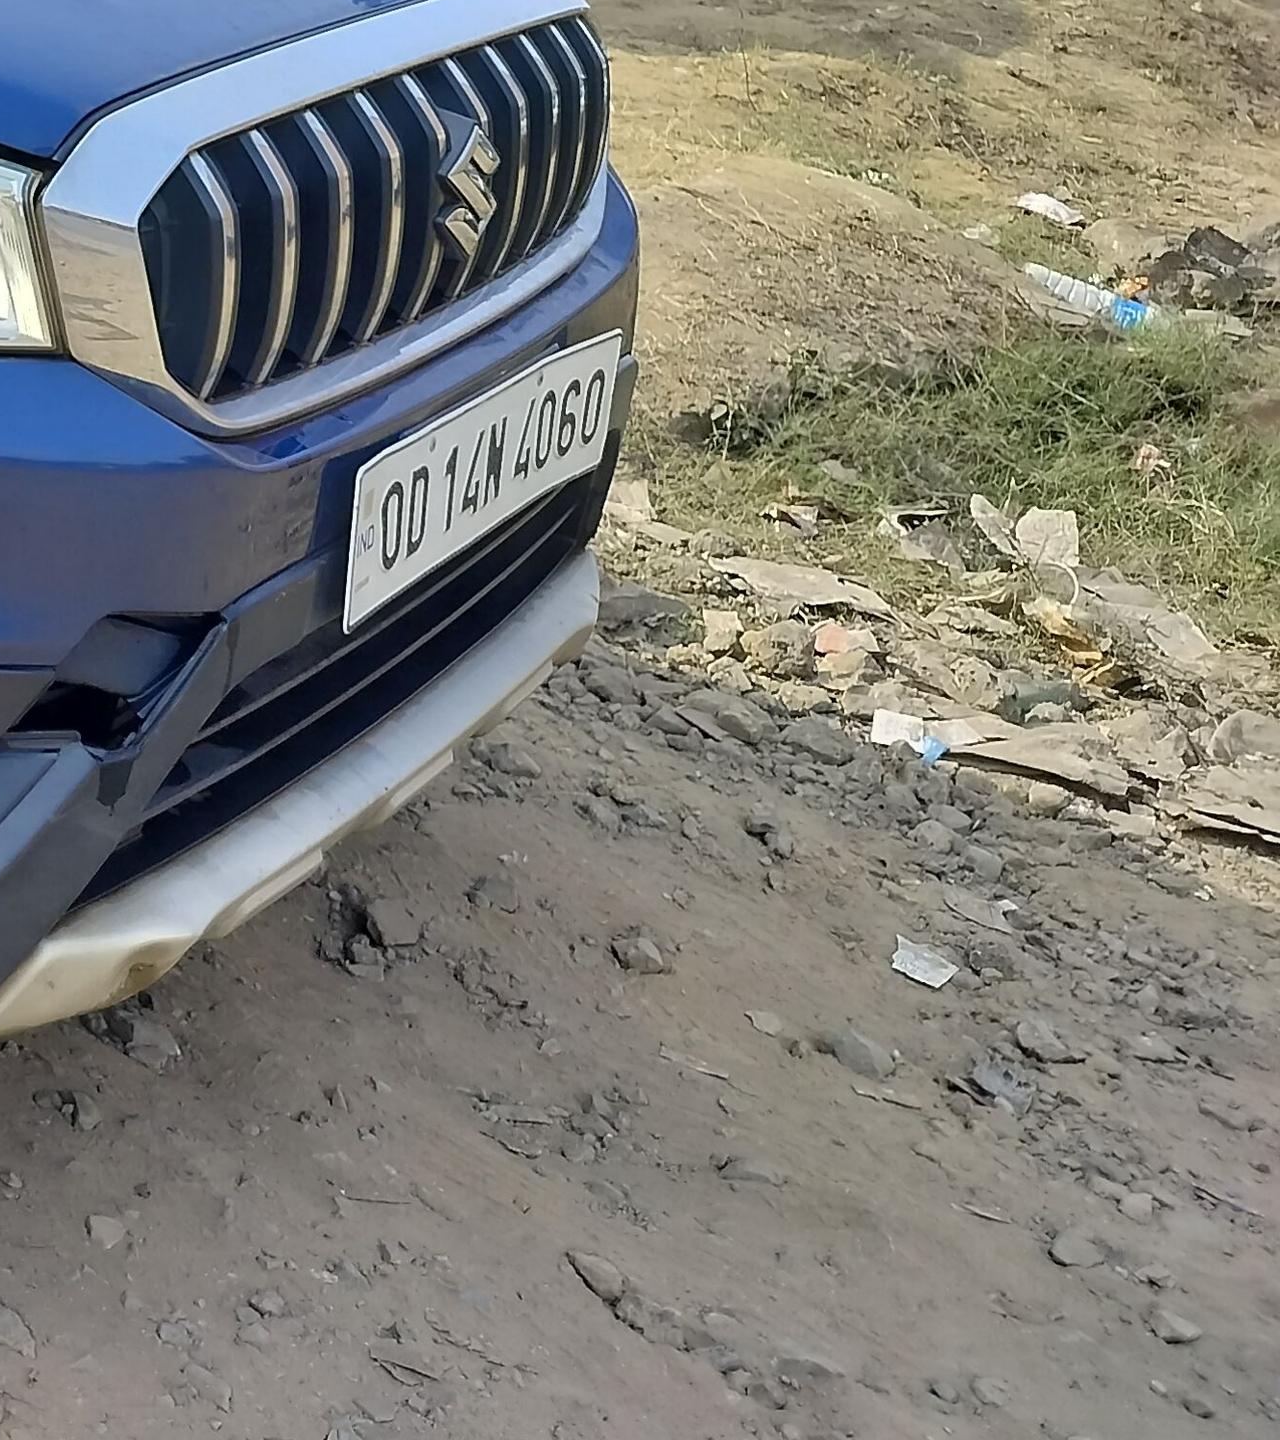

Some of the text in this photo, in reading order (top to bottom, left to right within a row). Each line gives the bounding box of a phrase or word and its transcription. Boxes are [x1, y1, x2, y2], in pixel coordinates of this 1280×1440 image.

[380, 465, 430, 570] OD
[513, 368, 606, 480] 4060
[357, 523, 375, 559] IND
